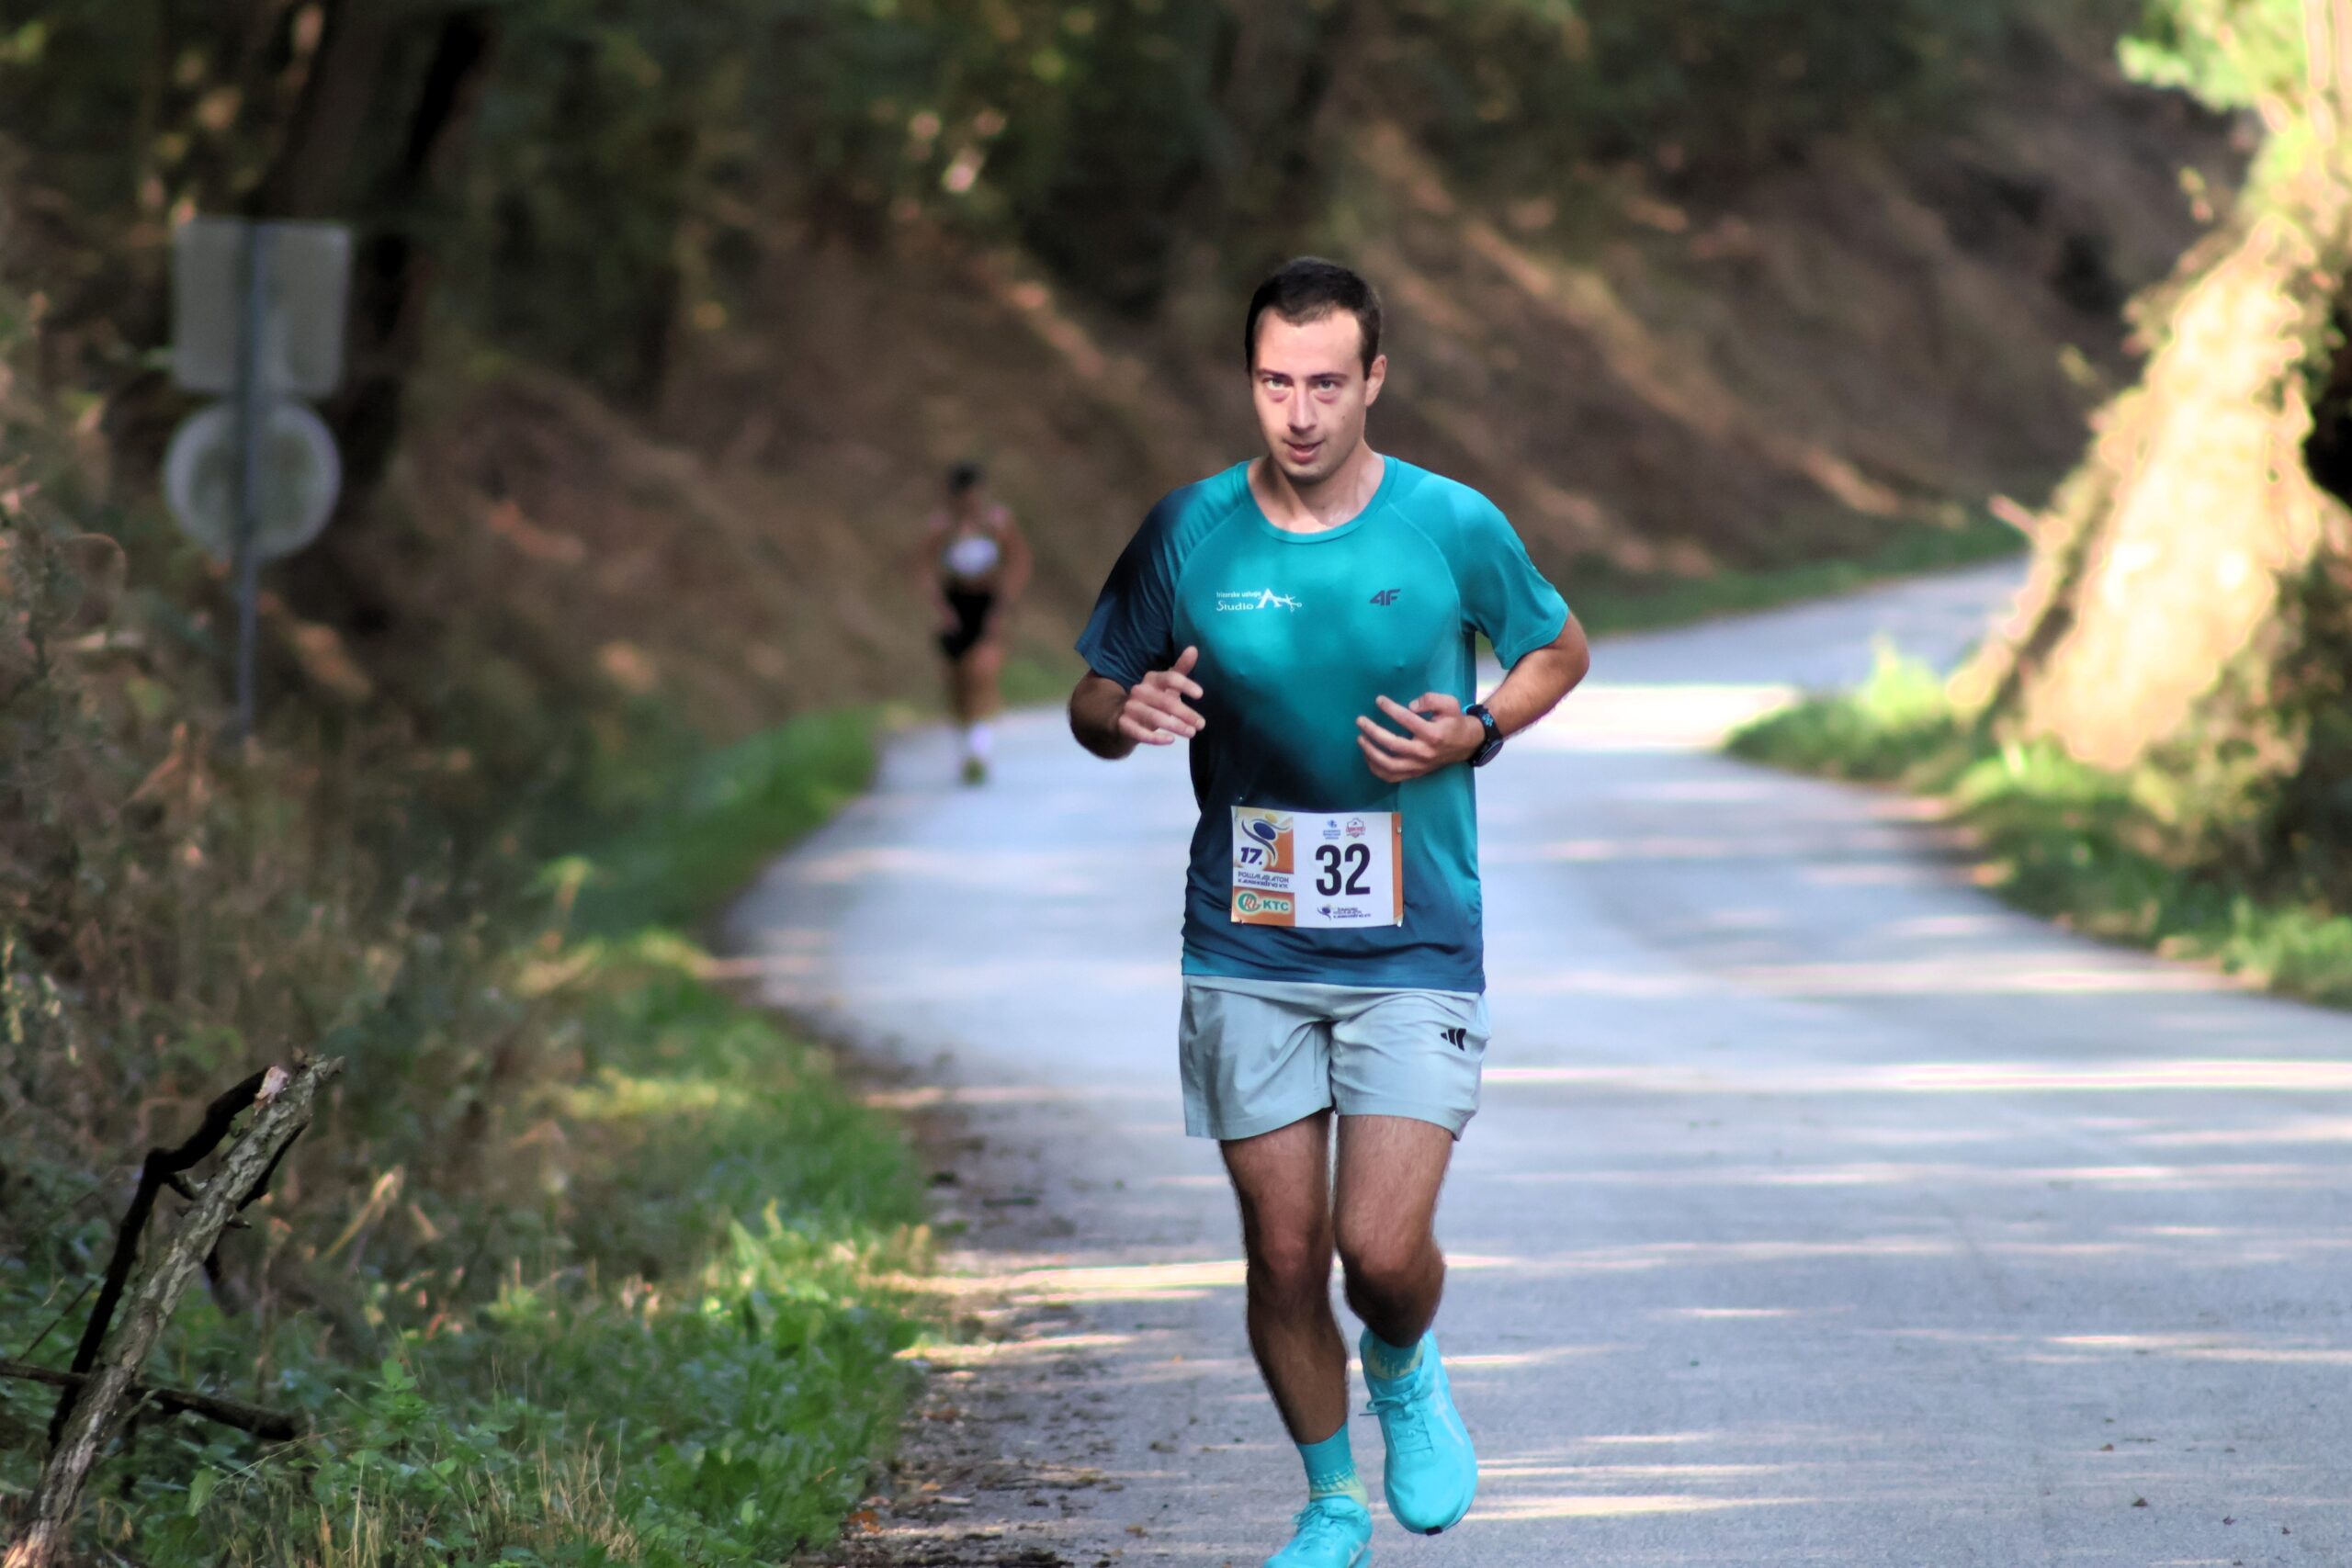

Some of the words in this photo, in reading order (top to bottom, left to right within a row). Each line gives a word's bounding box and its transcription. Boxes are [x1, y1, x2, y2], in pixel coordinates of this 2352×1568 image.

[1369, 589, 1401, 605] 4F
[1216, 600, 1254, 612] Studio
[1240, 847, 1262, 865] 17.
[1316, 843, 1371, 897] 32
[1263, 899, 1289, 911] KTC
